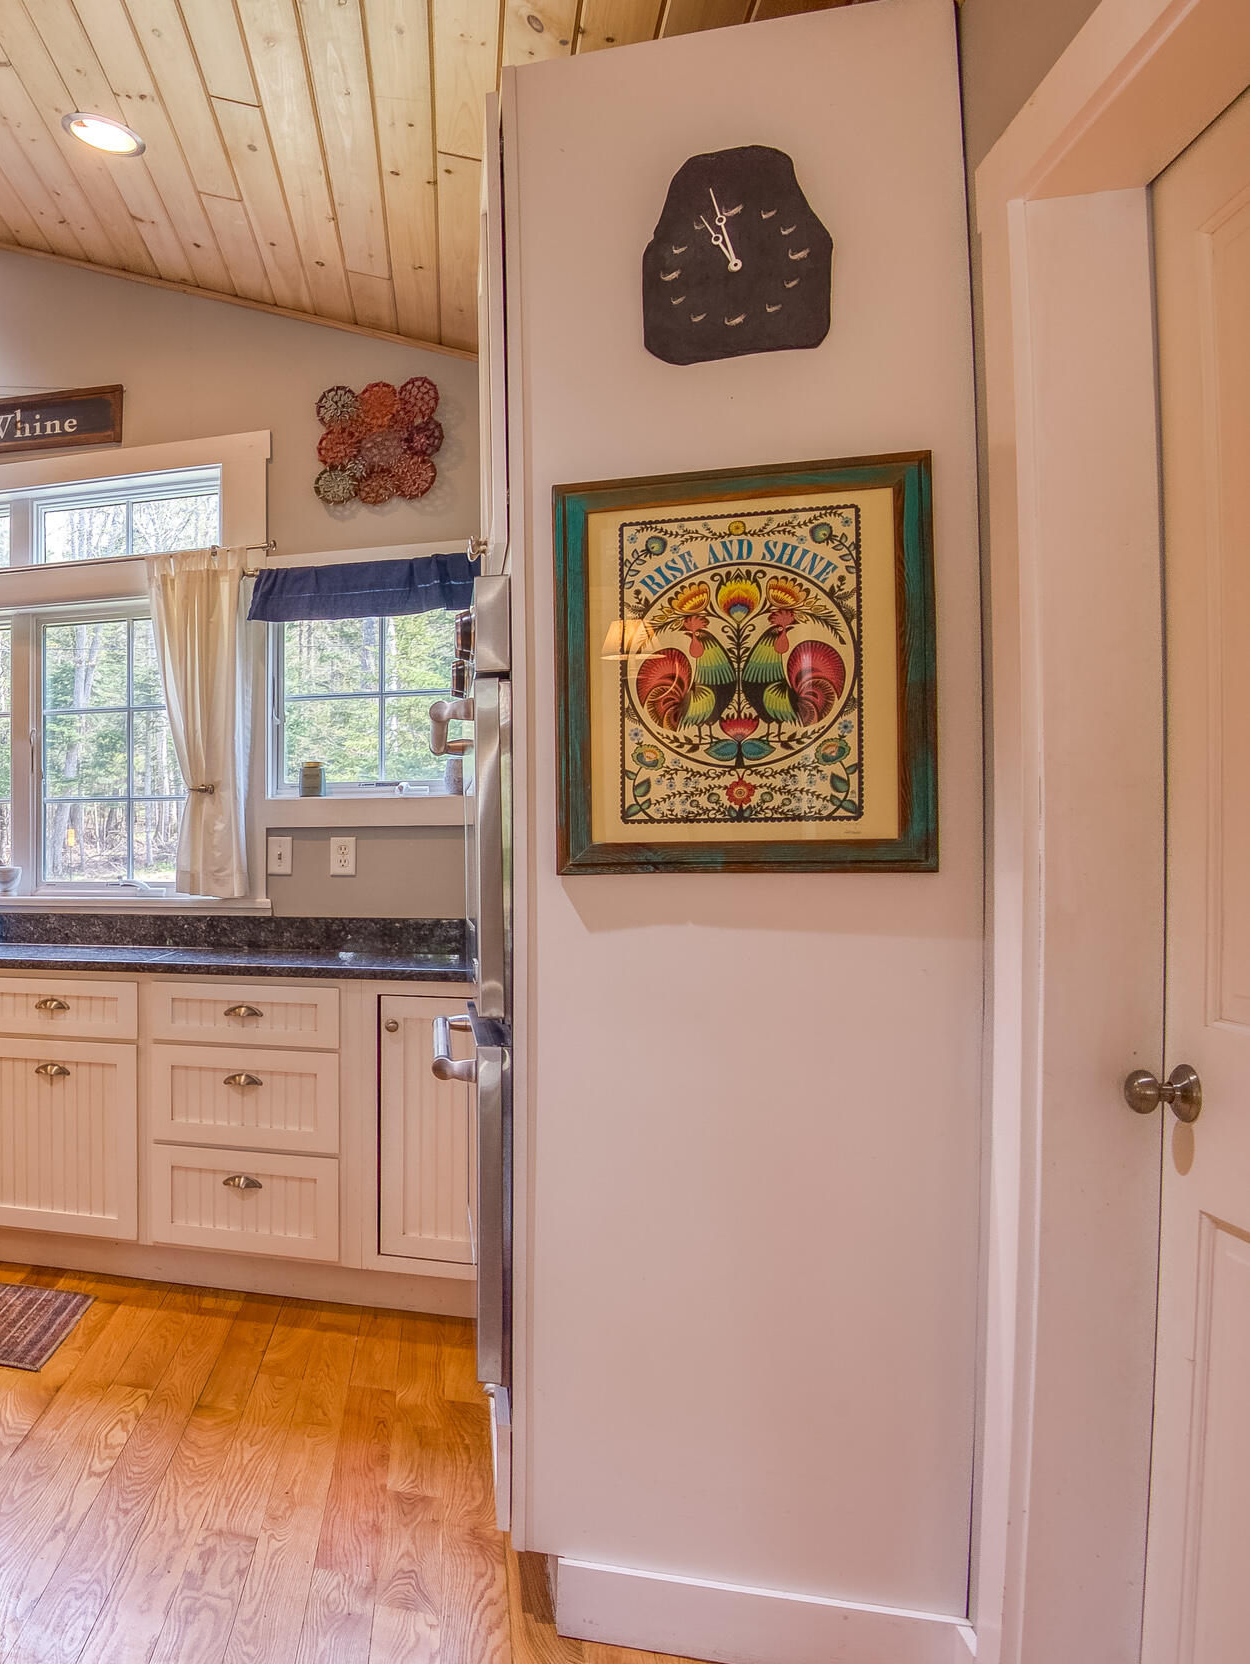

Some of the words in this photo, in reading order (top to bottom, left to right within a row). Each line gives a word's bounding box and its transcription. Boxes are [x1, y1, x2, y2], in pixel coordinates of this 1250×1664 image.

[639, 550, 699, 596] RISE
[707, 538, 753, 565] AND
[761, 539, 838, 584] SHINE
